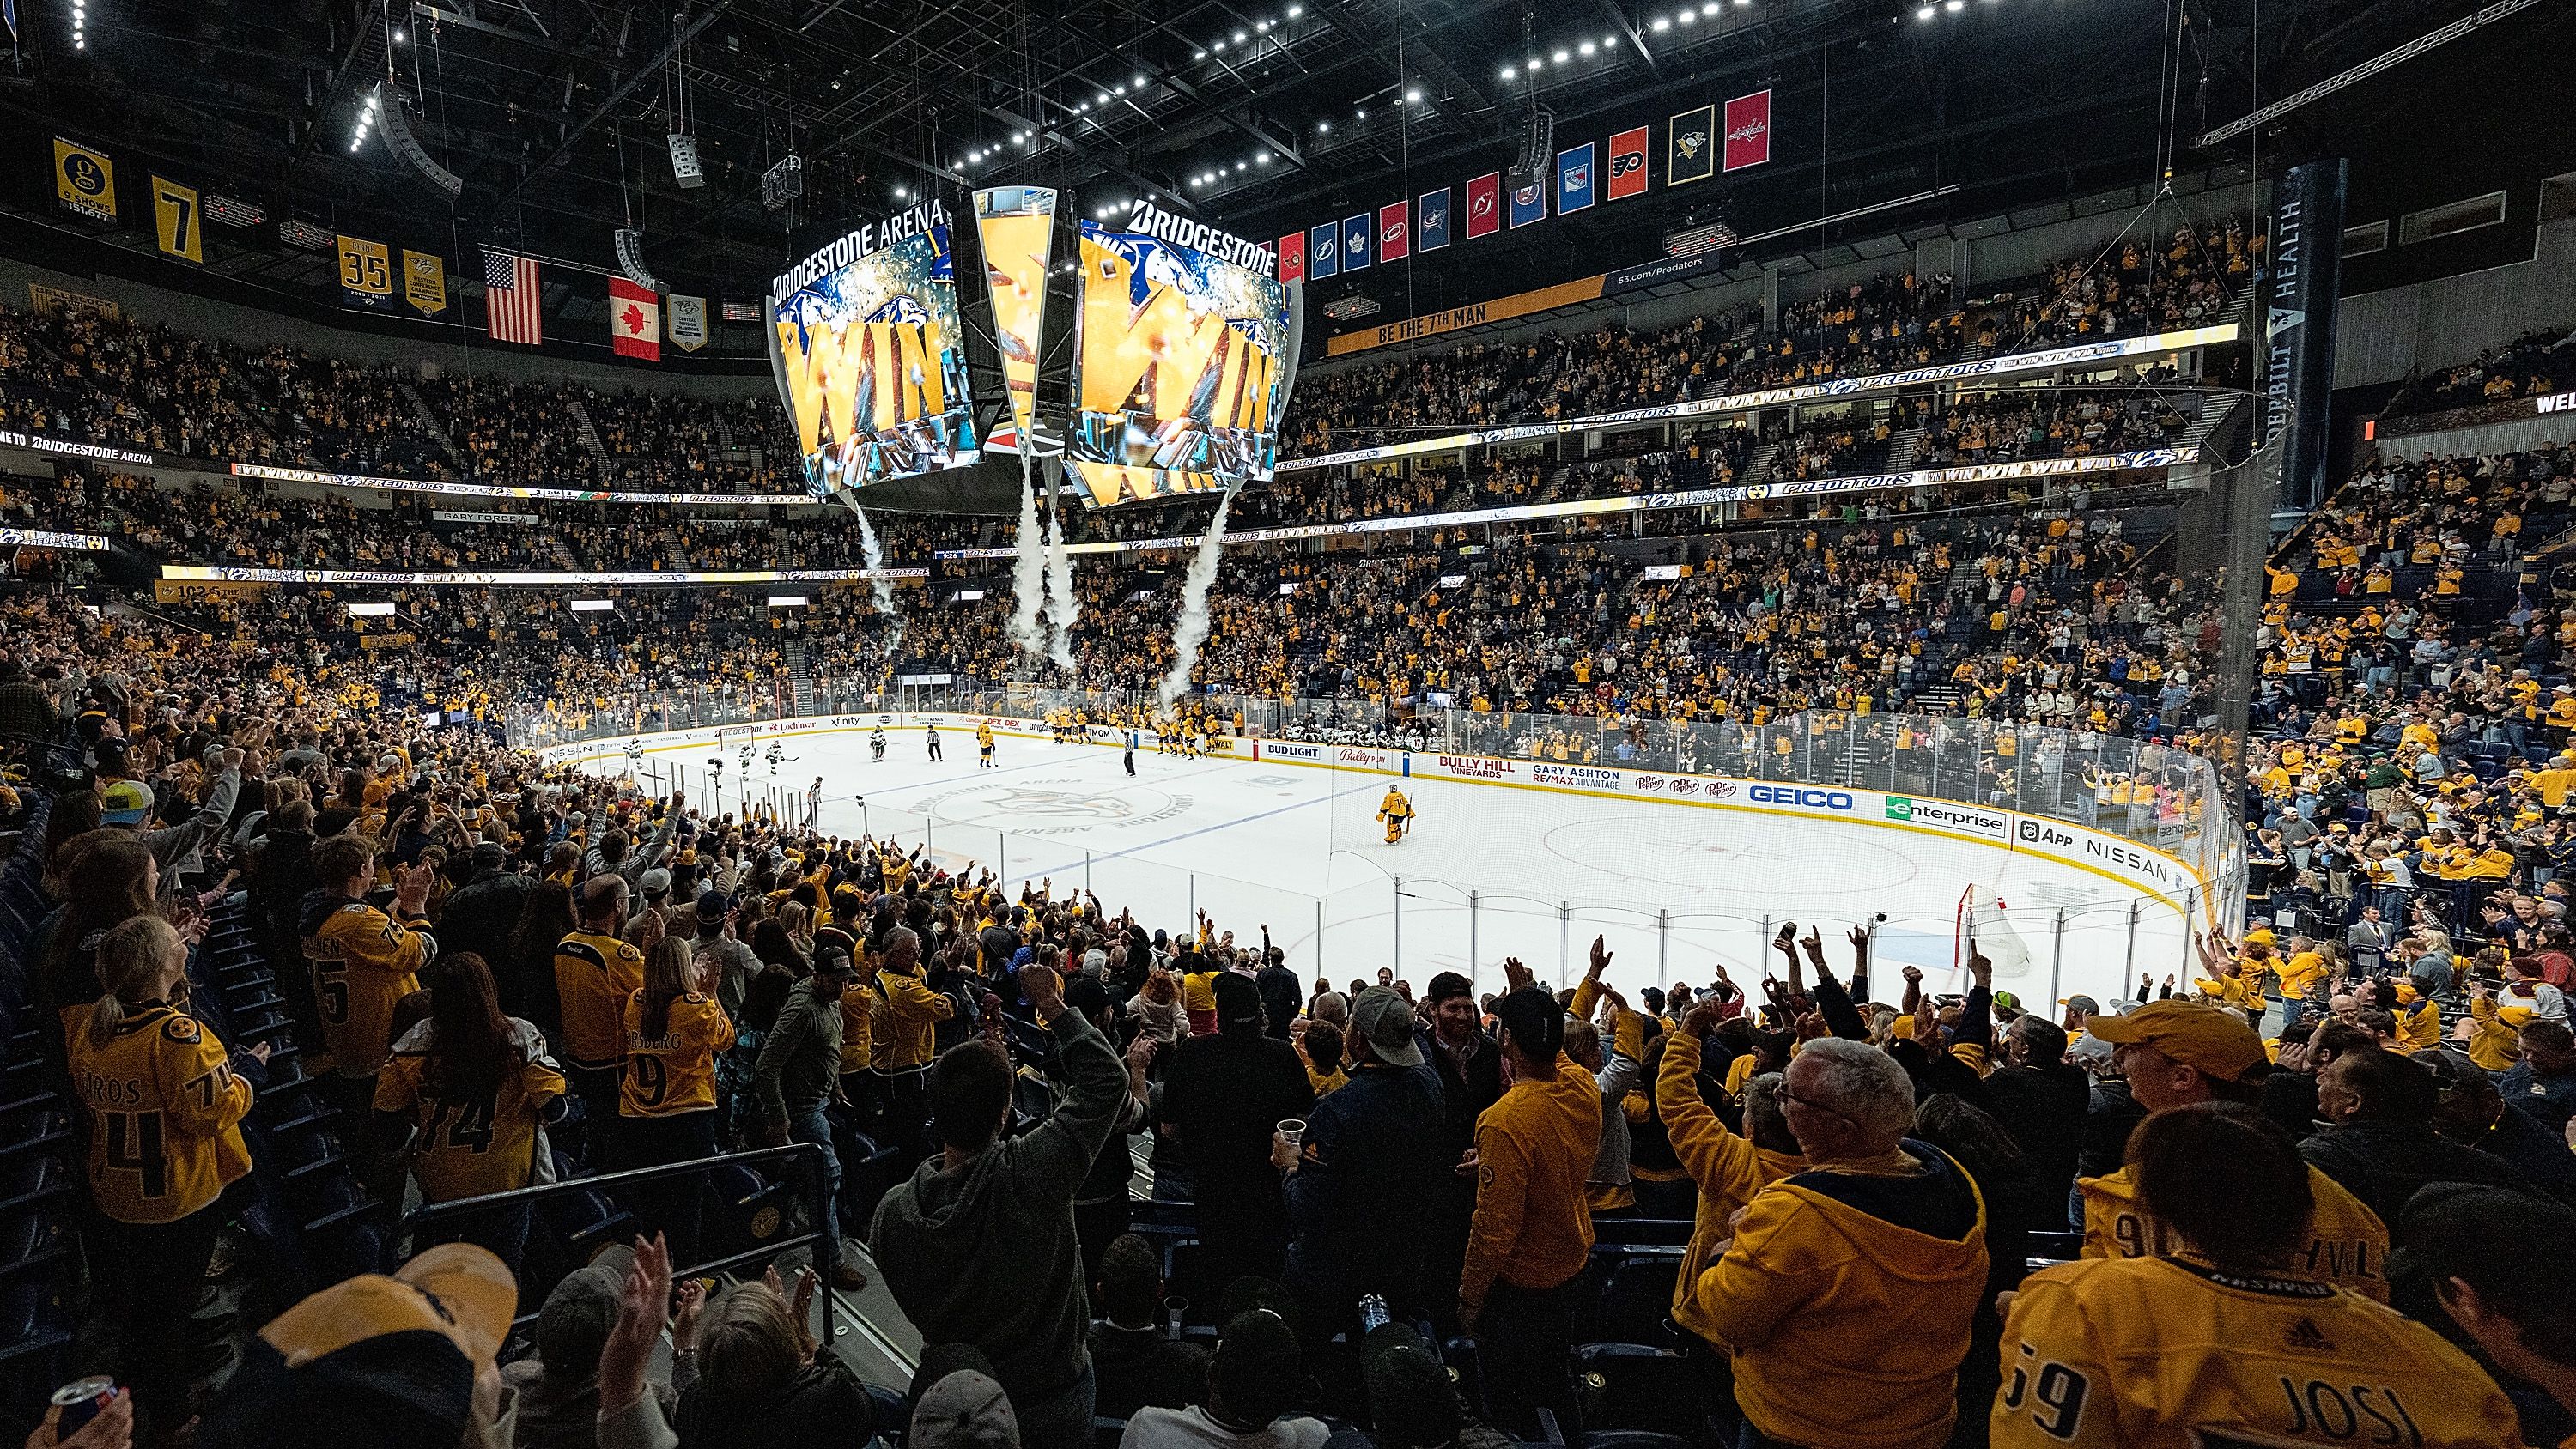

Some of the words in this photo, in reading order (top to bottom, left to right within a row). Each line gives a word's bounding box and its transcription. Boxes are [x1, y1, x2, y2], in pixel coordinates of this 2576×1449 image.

[75, 195, 111, 212] SHOWS
[161, 189, 192, 254] 7
[1127, 198, 1277, 276] BRIDGESTONE
[352, 241, 374, 252] RINNE
[772, 222, 874, 306] BRIDGESTONE
[878, 198, 944, 249] ARENA
[2275, 200, 2301, 298] HEALTH
[343, 251, 388, 290] 35
[1618, 257, 1703, 285] 53.com/Predators
[1378, 325, 1394, 344] BE
[1398, 319, 1424, 339] THE
[1428, 313, 1449, 332] 7TH
[1454, 305, 1486, 328] MAN
[1080, 235, 1274, 433] WIN
[1862, 360, 1996, 389] PREDATORS
[2018, 355, 2039, 366] WIN
[2042, 352, 2069, 362] WIN
[2071, 348, 2096, 358] WIN
[776, 321, 945, 457] WIN
[1700, 400, 1722, 411] WIN
[1725, 395, 1757, 408] WIN
[1760, 389, 1792, 403] WIN
[15, 434, 26, 446] TO
[32, 436, 118, 460] BRIDGESTONE
[120, 452, 153, 464] ARENA
[1274, 457, 1326, 471] REDATORS
[243, 465, 261, 476] WIN
[264, 468, 289, 479] WIN
[292, 470, 315, 481] WIN
[1783, 473, 1913, 494] PREDATORS
[1945, 468, 1977, 481] WIN
[1981, 463, 2025, 479] WIN
[2032, 458, 2075, 475] WIN
[2079, 457, 2111, 470] WIN
[365, 478, 444, 491] PREDATORS
[690, 494, 754, 503] PREDATORS
[444, 512, 473, 521] GARY
[477, 514, 516, 523] FORCE
[1219, 532, 1259, 543] DATORS
[1287, 528, 1305, 537] WIN
[1309, 525, 1326, 535] WIN
[332, 573, 416, 582] PREDATORS
[434, 573, 451, 582] WIN
[867, 569, 930, 578] PREDATORS
[222, 587, 239, 597] THE
[780, 721, 817, 731] Lochinvar
[831, 717, 860, 727] xfinity
[1029, 723, 1054, 733] BRIDGEST
[714, 725, 763, 737] BRIDGESTONE
[1214, 739, 1233, 749] WALT
[1268, 744, 1289, 755] BUD
[1290, 746, 1318, 757] LIGHT
[549, 745, 592, 764] NSSAN
[1339, 748, 1370, 765] Bally
[1371, 755, 1386, 764] PLAY
[1439, 755, 1482, 770] BULLY
[1485, 760, 1516, 773] HILL
[1533, 764, 1565, 776] GARY
[1570, 767, 1619, 780] ASHTON
[1451, 767, 1502, 779] VINEYARDS
[1533, 773, 1574, 785] RE/MAX
[1575, 779, 1619, 790] ADVANTAGE
[1645, 775, 1656, 784] Dr
[1636, 778, 1663, 791] Pepper
[1670, 780, 1698, 794] Pepper
[1680, 778, 1691, 786] Dr
[1705, 784, 1735, 797] Pepper
[1716, 781, 1727, 790] Dr
[1394, 798, 1405, 809] 74
[1749, 785, 1853, 810] GEICO
[1888, 802, 2003, 831] enterprise
[2041, 828, 2073, 847] App
[2087, 839, 2167, 882] NISSAN
[567, 945, 583, 955] Reebok
[314, 958, 350, 1026] 5
[626, 1030, 682, 1050] RSBERG
[635, 1052, 668, 1107] 9
[104, 1108, 169, 1200] 4
[2003, 1339, 2088, 1444] 59
[2277, 1376, 2421, 1449] JOSI
